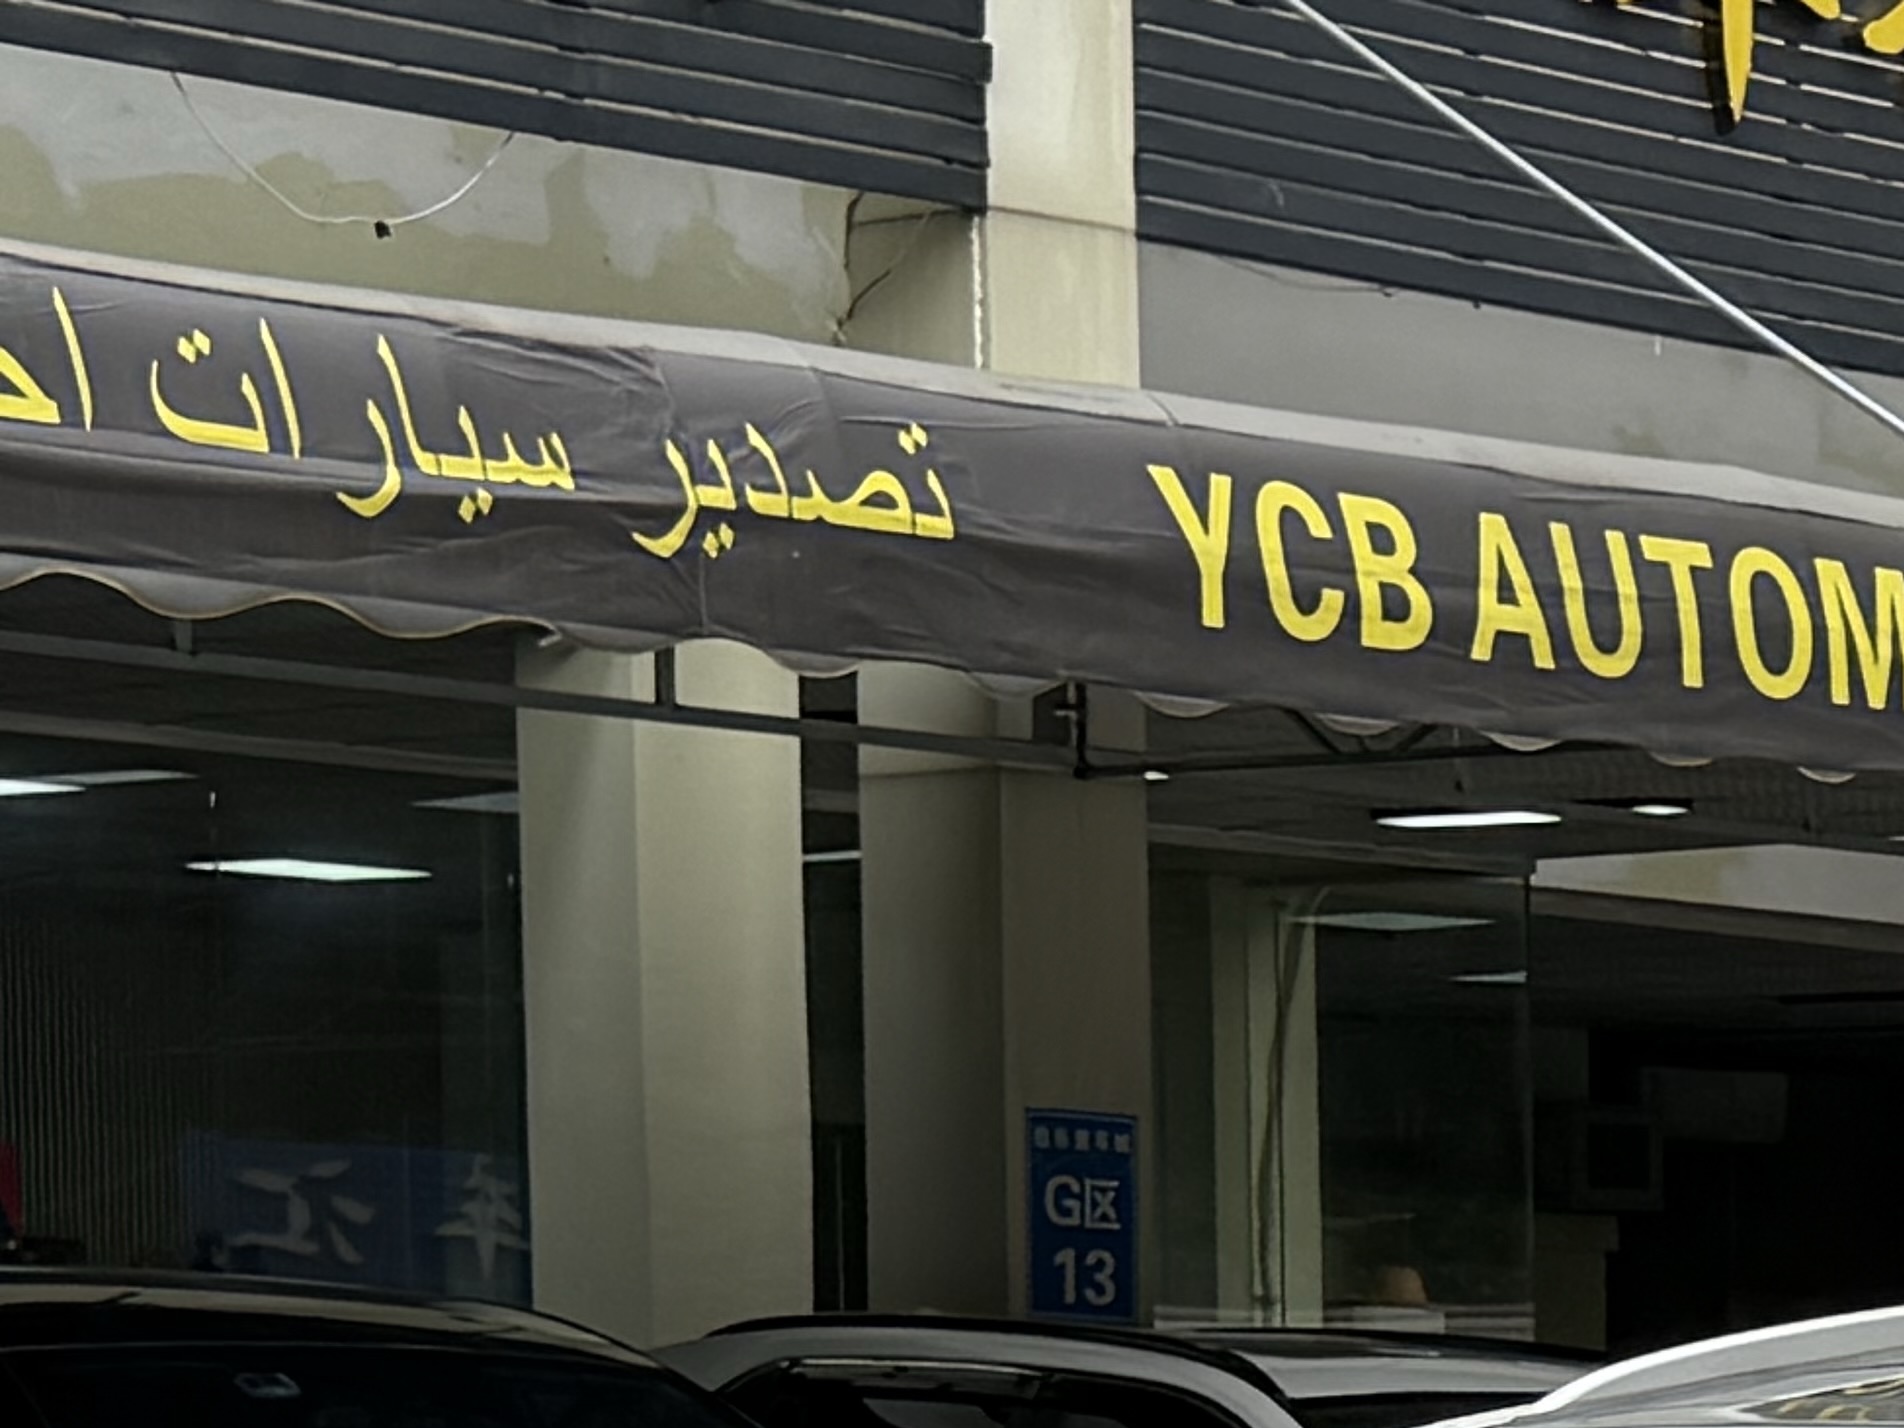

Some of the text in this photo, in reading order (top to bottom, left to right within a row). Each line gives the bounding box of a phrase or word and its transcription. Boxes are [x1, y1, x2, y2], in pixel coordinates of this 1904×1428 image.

[150, 318, 576, 522] سيارات
[632, 422, 955, 559] تصدير
[1147, 463, 1433, 651] YCB
[1044, 1173, 1122, 1231] G区
[1053, 1247, 1118, 1307] 13
